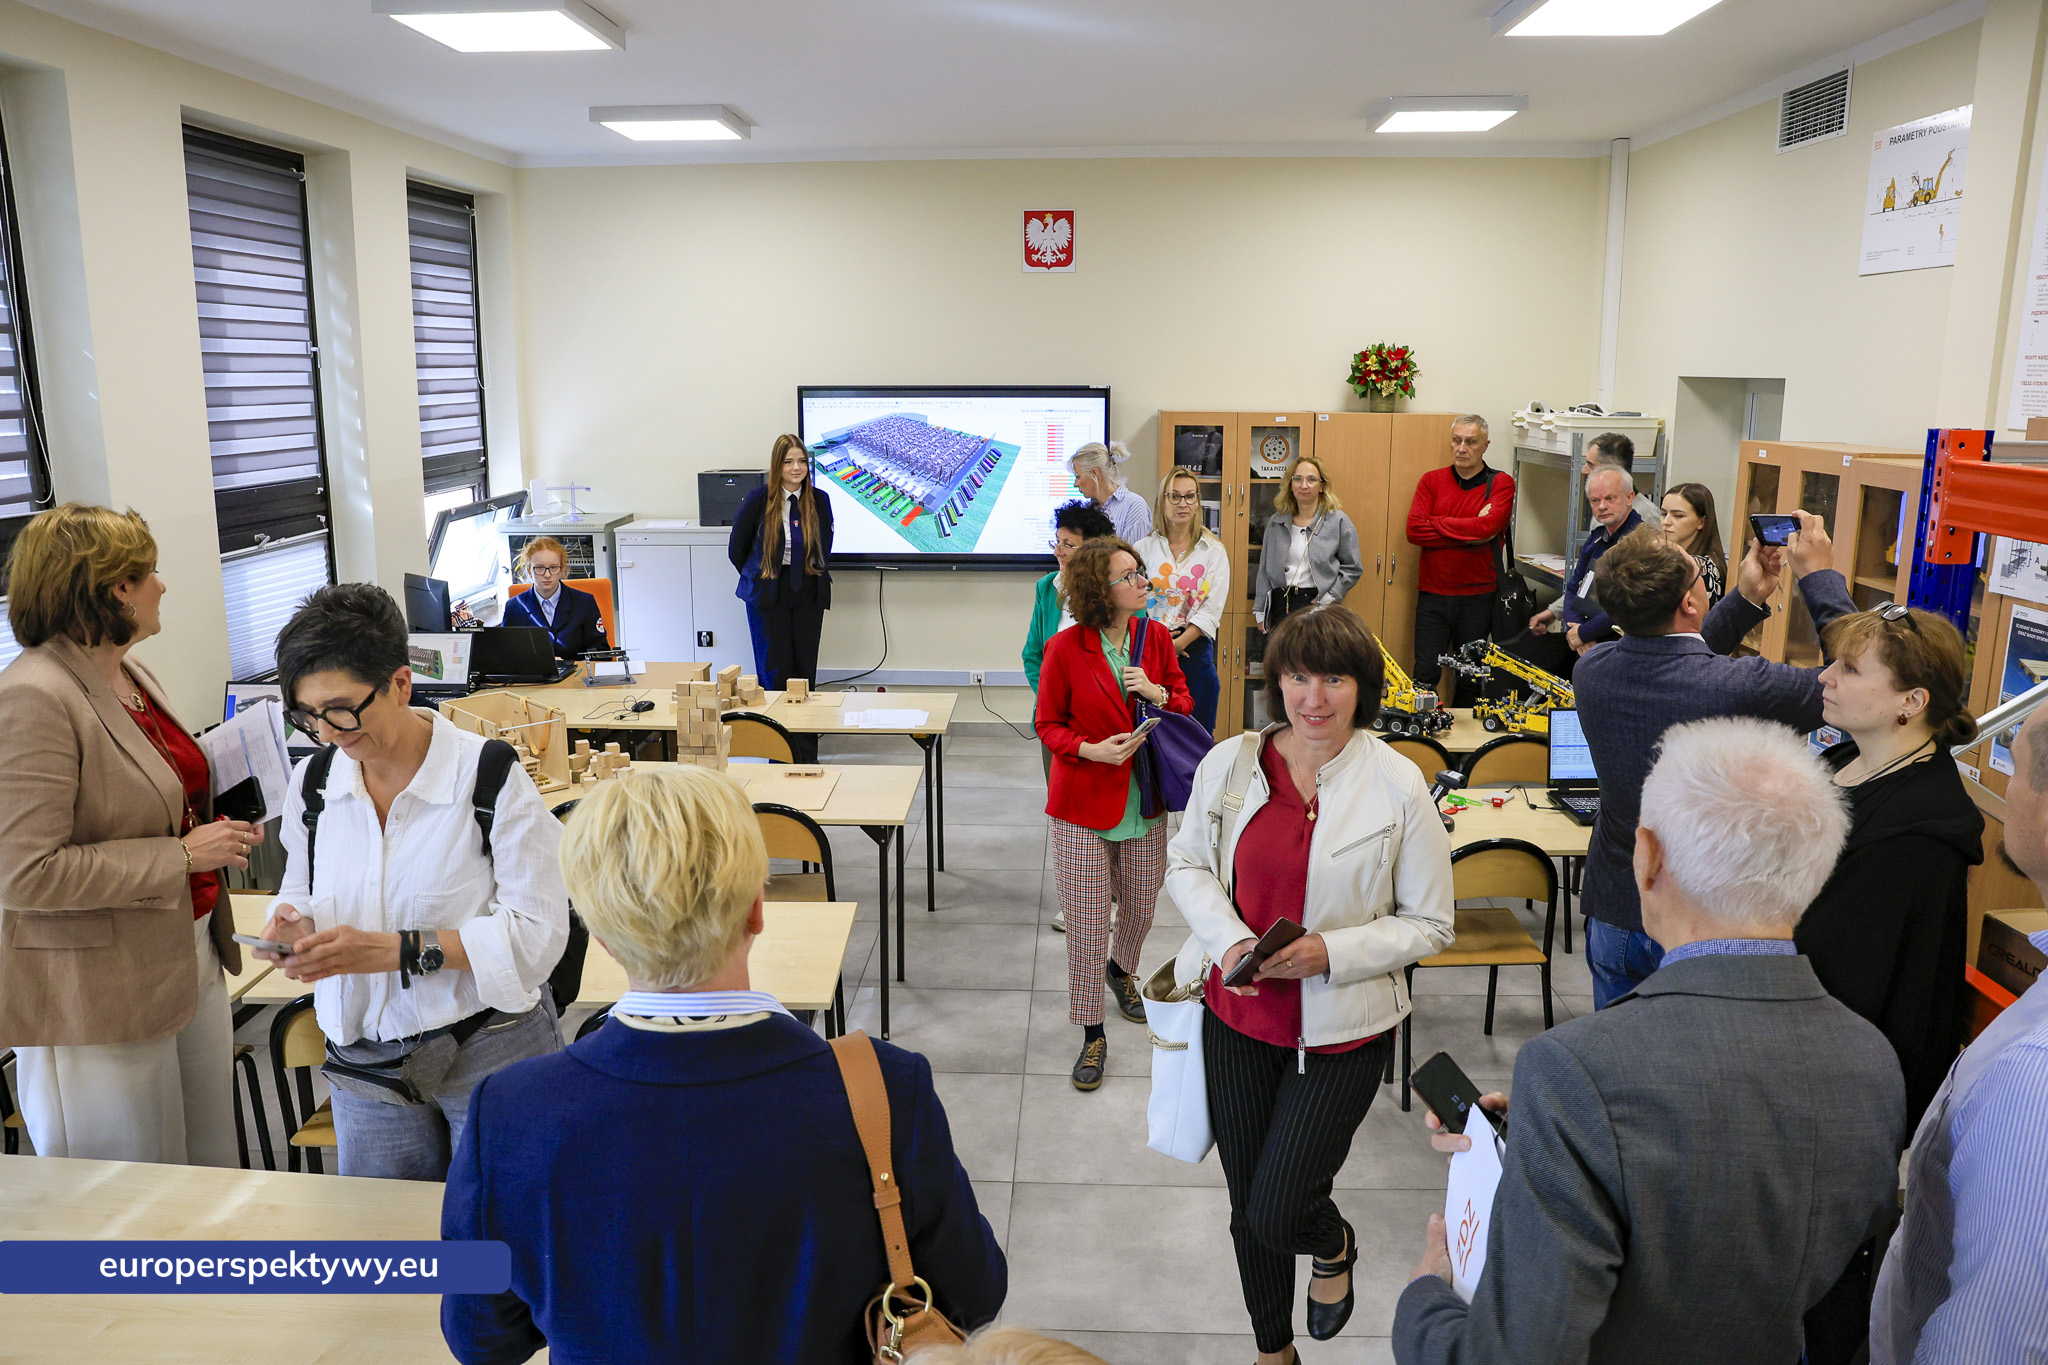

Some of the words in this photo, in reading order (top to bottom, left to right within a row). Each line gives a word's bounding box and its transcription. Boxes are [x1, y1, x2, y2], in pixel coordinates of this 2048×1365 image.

[1889, 127, 1928, 146] PARAMETRY
[2034, 556, 2040, 565] A
[1456, 1197, 1476, 1268] ZDZ
